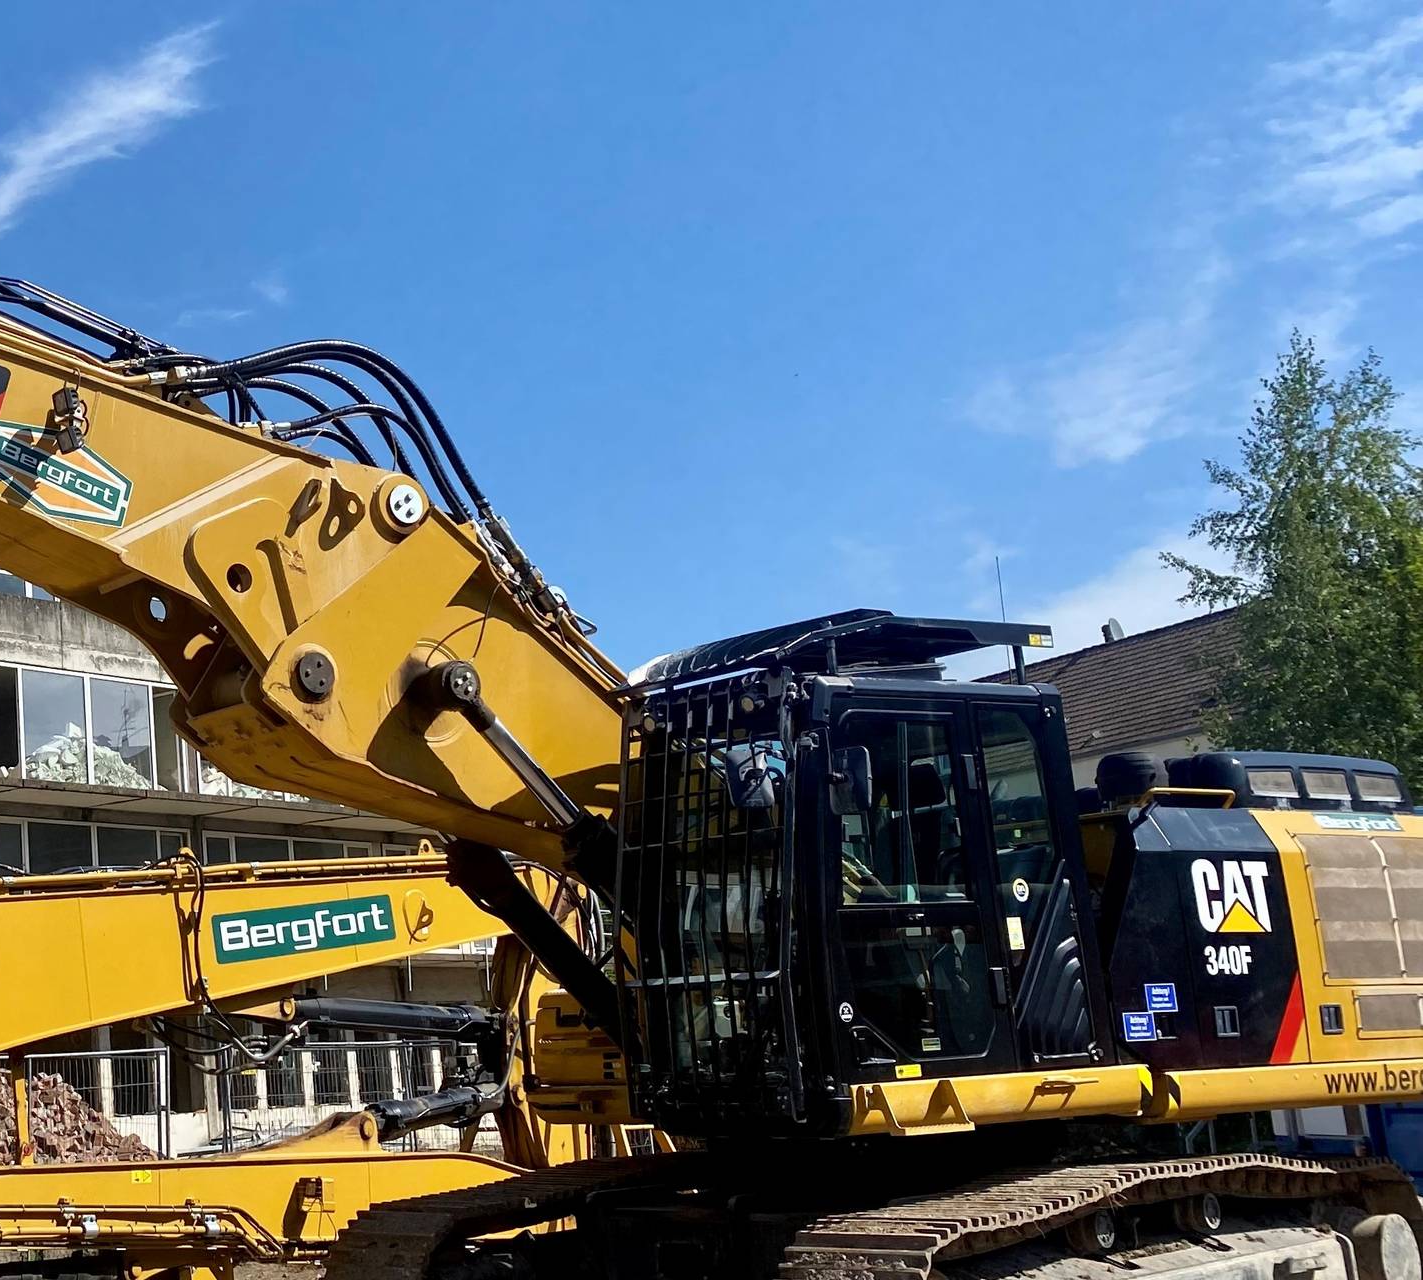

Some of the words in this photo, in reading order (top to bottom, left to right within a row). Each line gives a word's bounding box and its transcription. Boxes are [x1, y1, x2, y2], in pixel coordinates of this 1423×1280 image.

[0, 442, 115, 505] Bergfort
[1315, 814, 1401, 831] Bergfort
[1191, 858, 1272, 933] CAT
[219, 903, 389, 951] Bergfort
[1204, 945, 1253, 976] 340F
